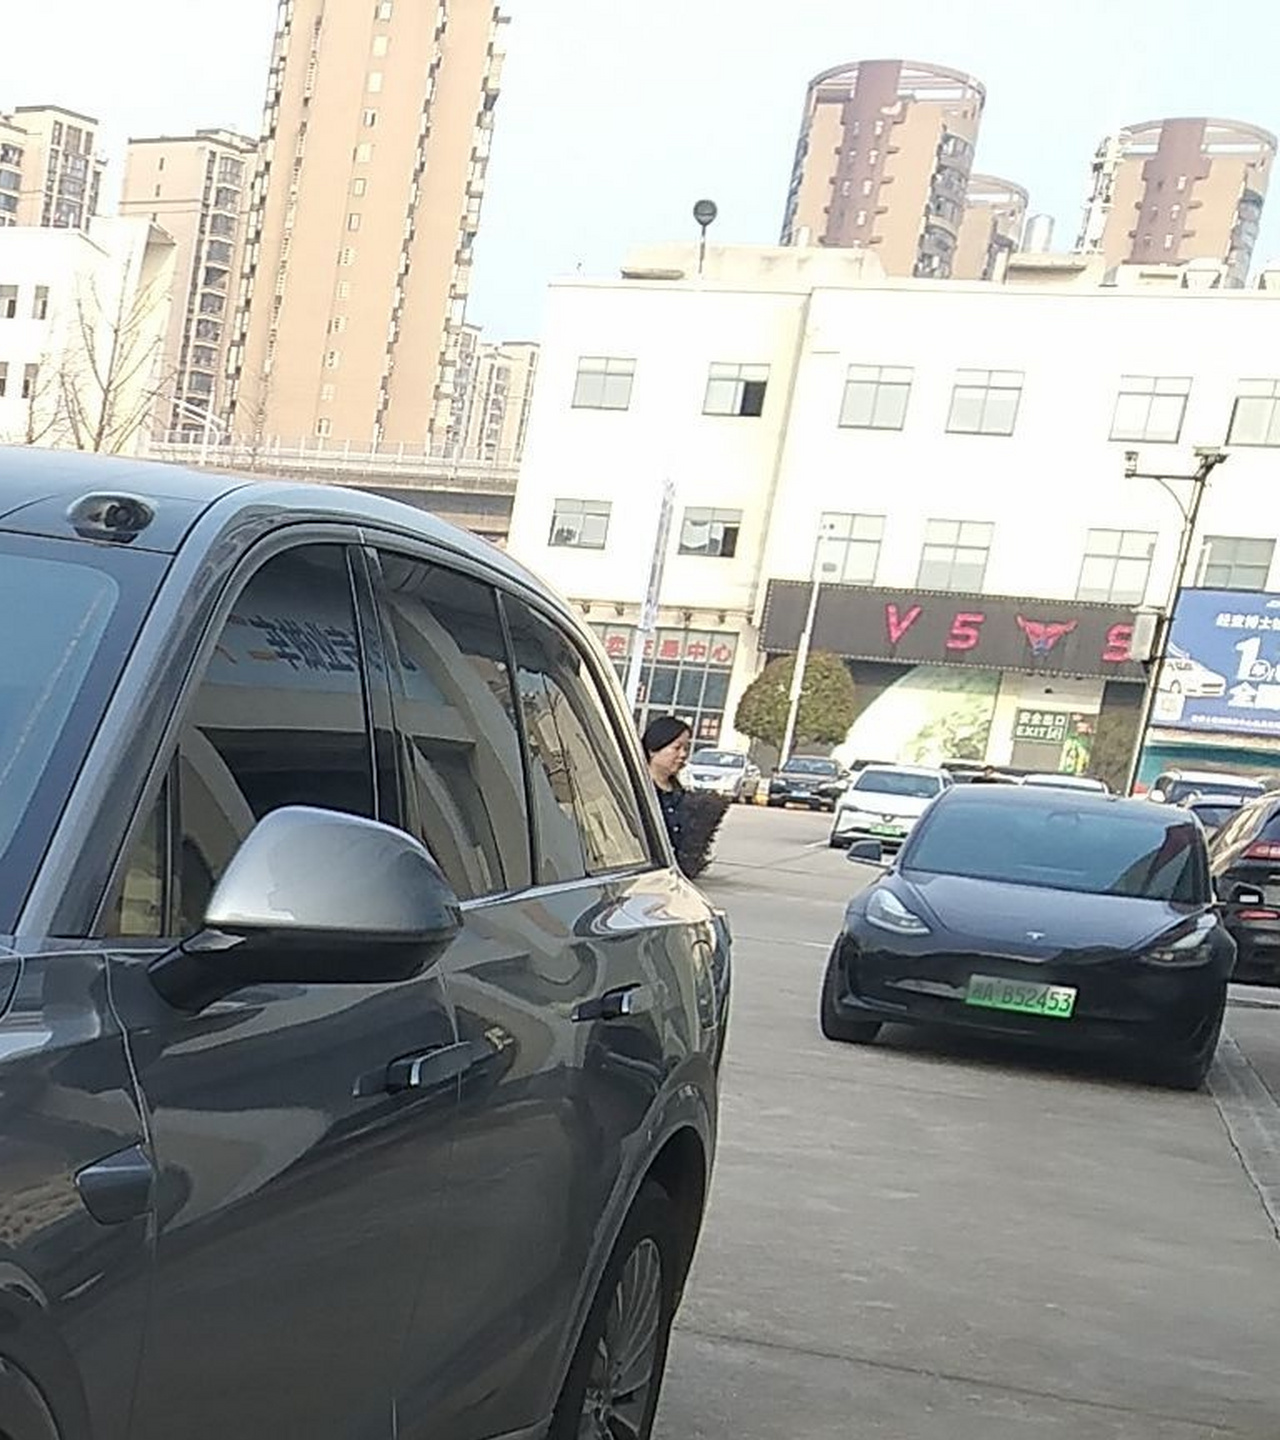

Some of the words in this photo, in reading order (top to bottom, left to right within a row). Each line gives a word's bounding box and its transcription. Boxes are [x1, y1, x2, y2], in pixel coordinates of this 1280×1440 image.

[1018, 711, 1066, 726] 安全出口
[1016, 725, 1047, 738] EXIT
